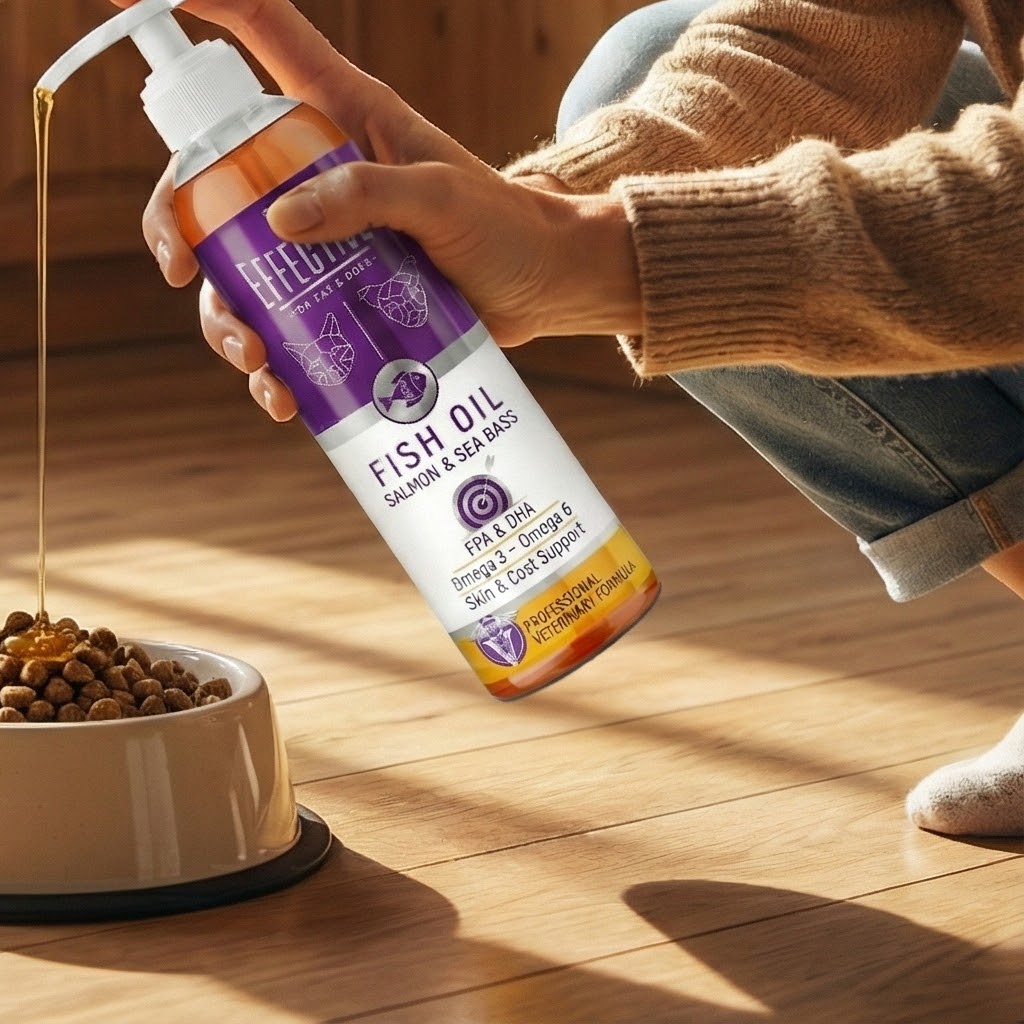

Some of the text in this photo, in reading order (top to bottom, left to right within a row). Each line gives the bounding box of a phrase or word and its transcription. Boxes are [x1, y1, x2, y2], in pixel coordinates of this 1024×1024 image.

[235, 231, 374, 310] EFFEC
[368, 386, 504, 487] FISH OIL
[384, 409, 519, 508] SALMON & SEA BASS
[464, 501, 537, 557] FPA & DHA
[465, 589, 497, 611] Skin
[494, 579, 509, 594] &
[536, 521, 587, 565] Support
[494, 549, 508, 565] 3
[518, 512, 564, 548] Omega
[561, 501, 573, 517] 6
